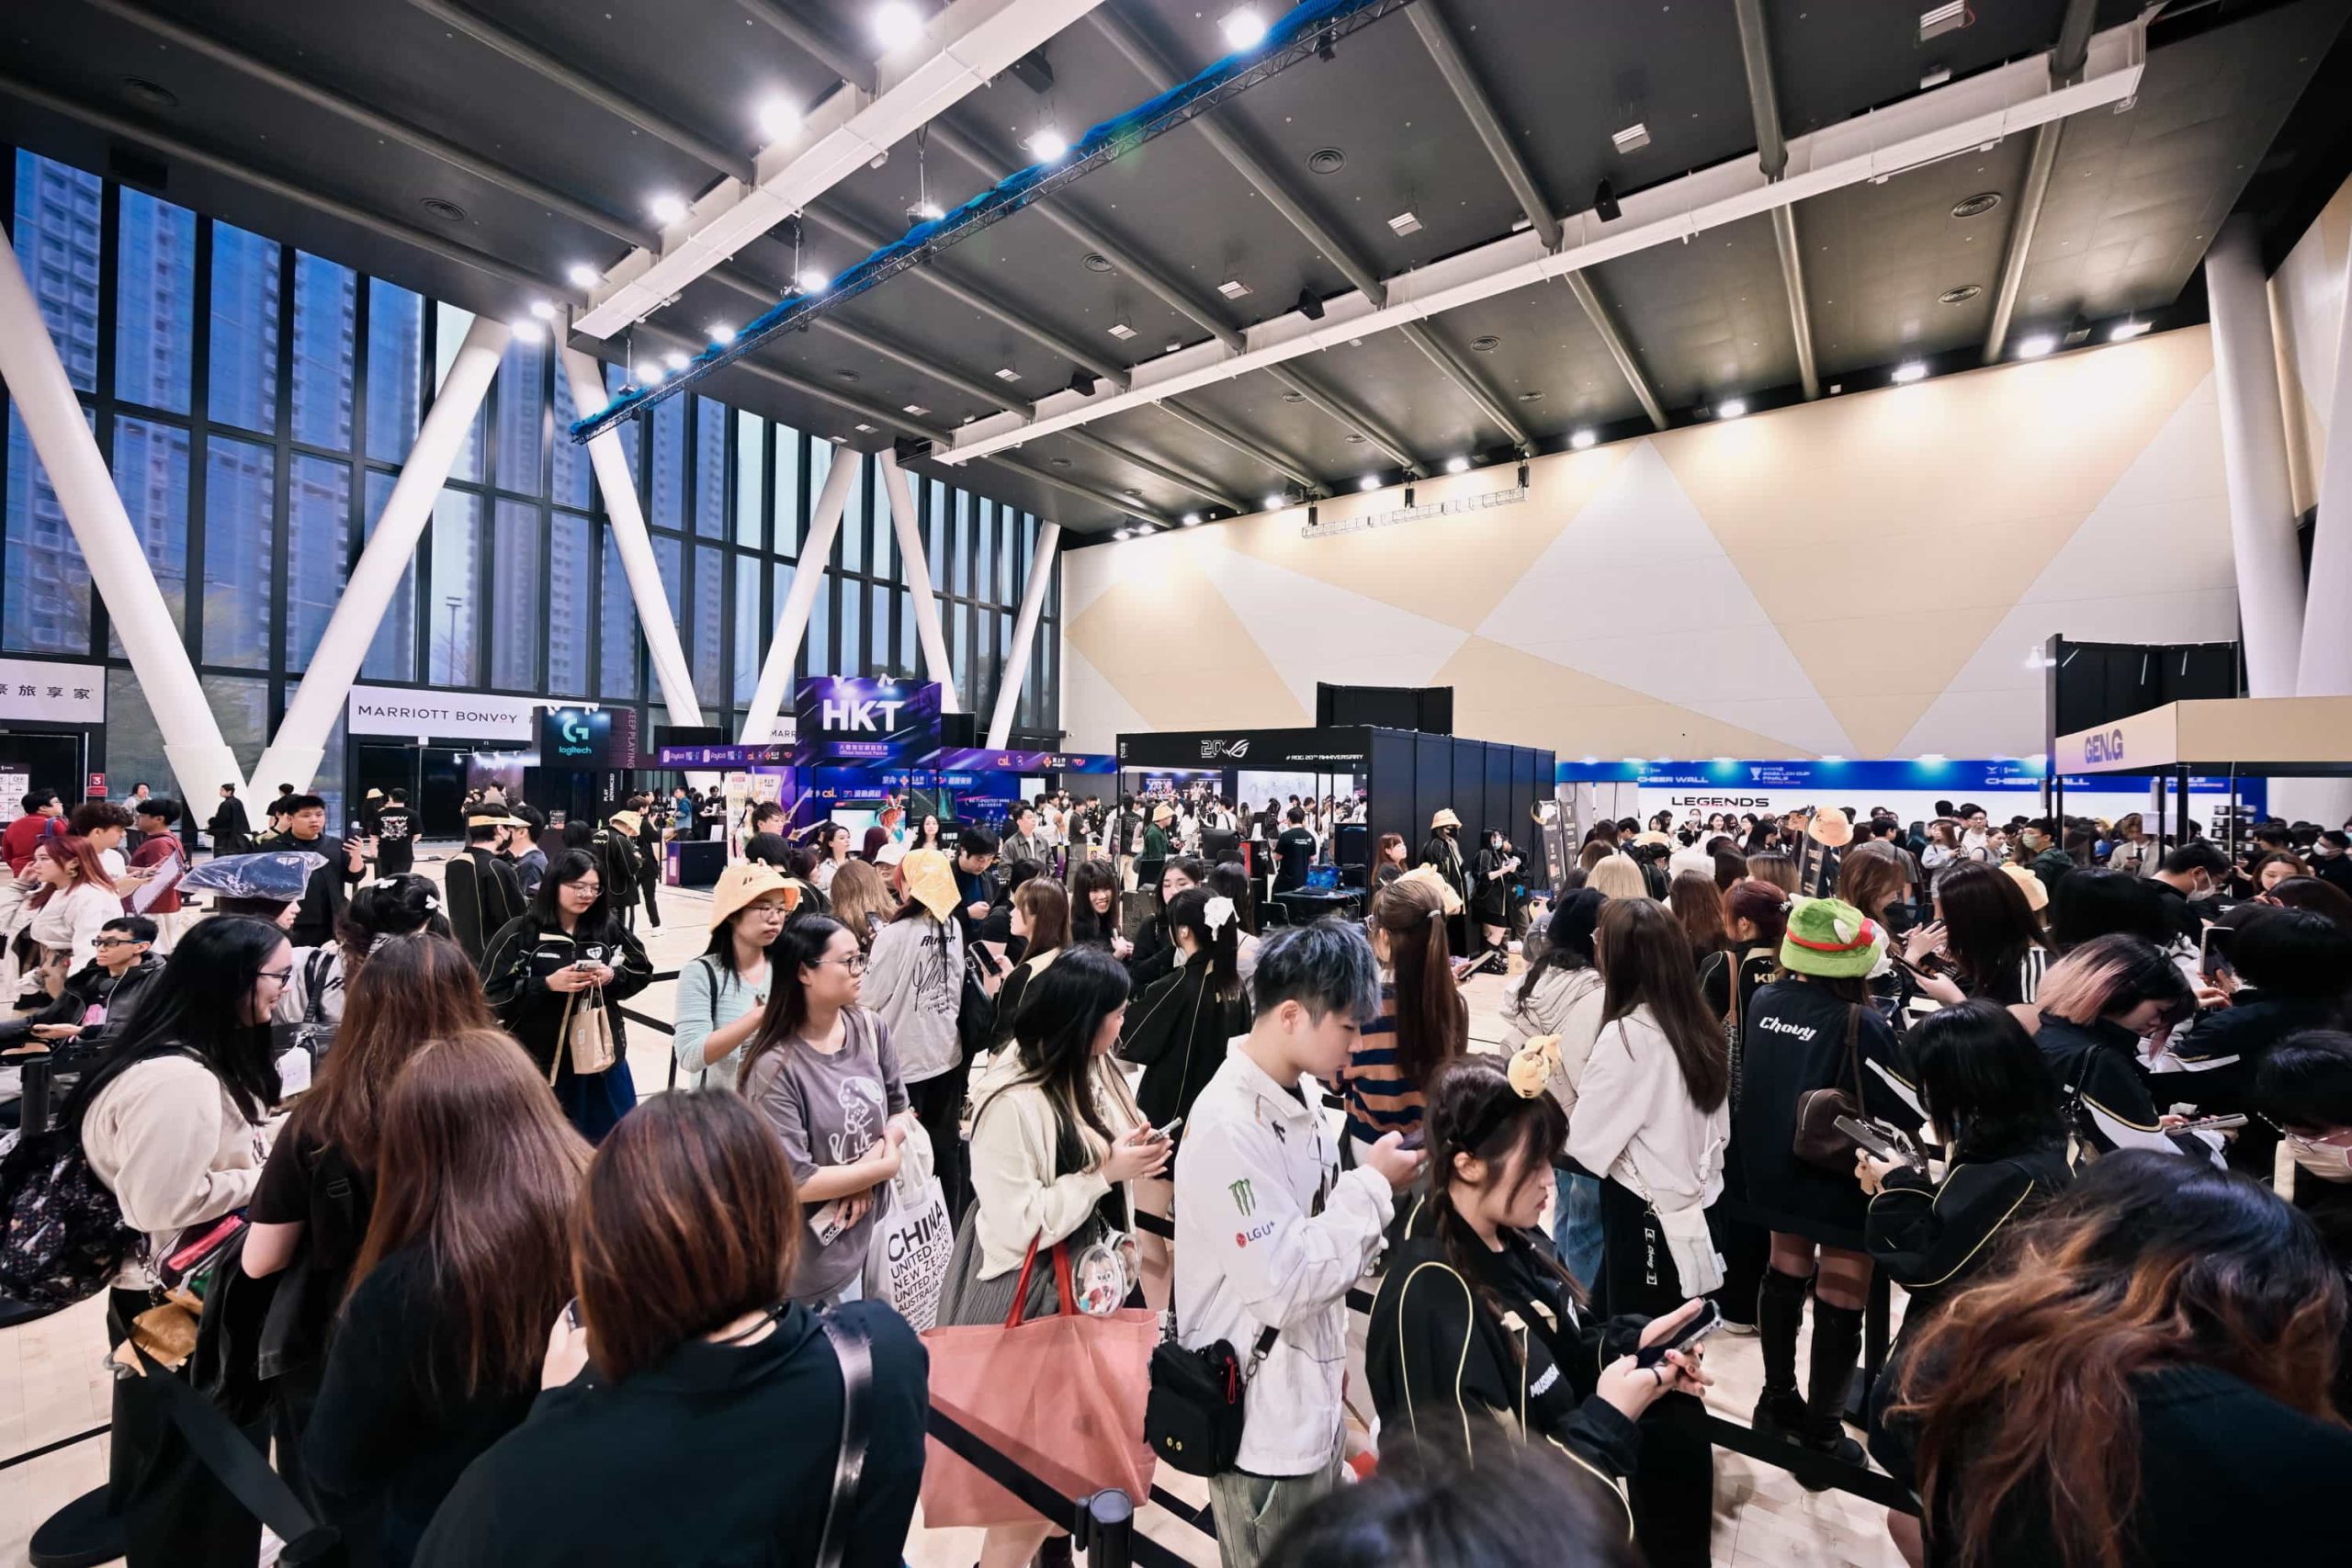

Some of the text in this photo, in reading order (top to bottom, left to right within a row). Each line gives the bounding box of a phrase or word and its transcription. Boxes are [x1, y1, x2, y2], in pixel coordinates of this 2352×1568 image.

[357, 705, 449, 721] MARRIOTT
[822, 699, 905, 732] HKT
[559, 746, 593, 756] logitech
[628, 731, 637, 769] PLAYING
[2085, 728, 2124, 764] GEN.G
[93, 776, 102, 785] 3
[1671, 796, 1770, 807] LEGENDS
[1759, 1016, 1817, 1042] Chovy
[888, 1199, 944, 1262] CHINA
[890, 1245, 933, 1280] UNITED
[893, 1267, 921, 1292] NEW
[894, 1275, 931, 1303] UNITED
[898, 1280, 939, 1313] AUSTRALIA
